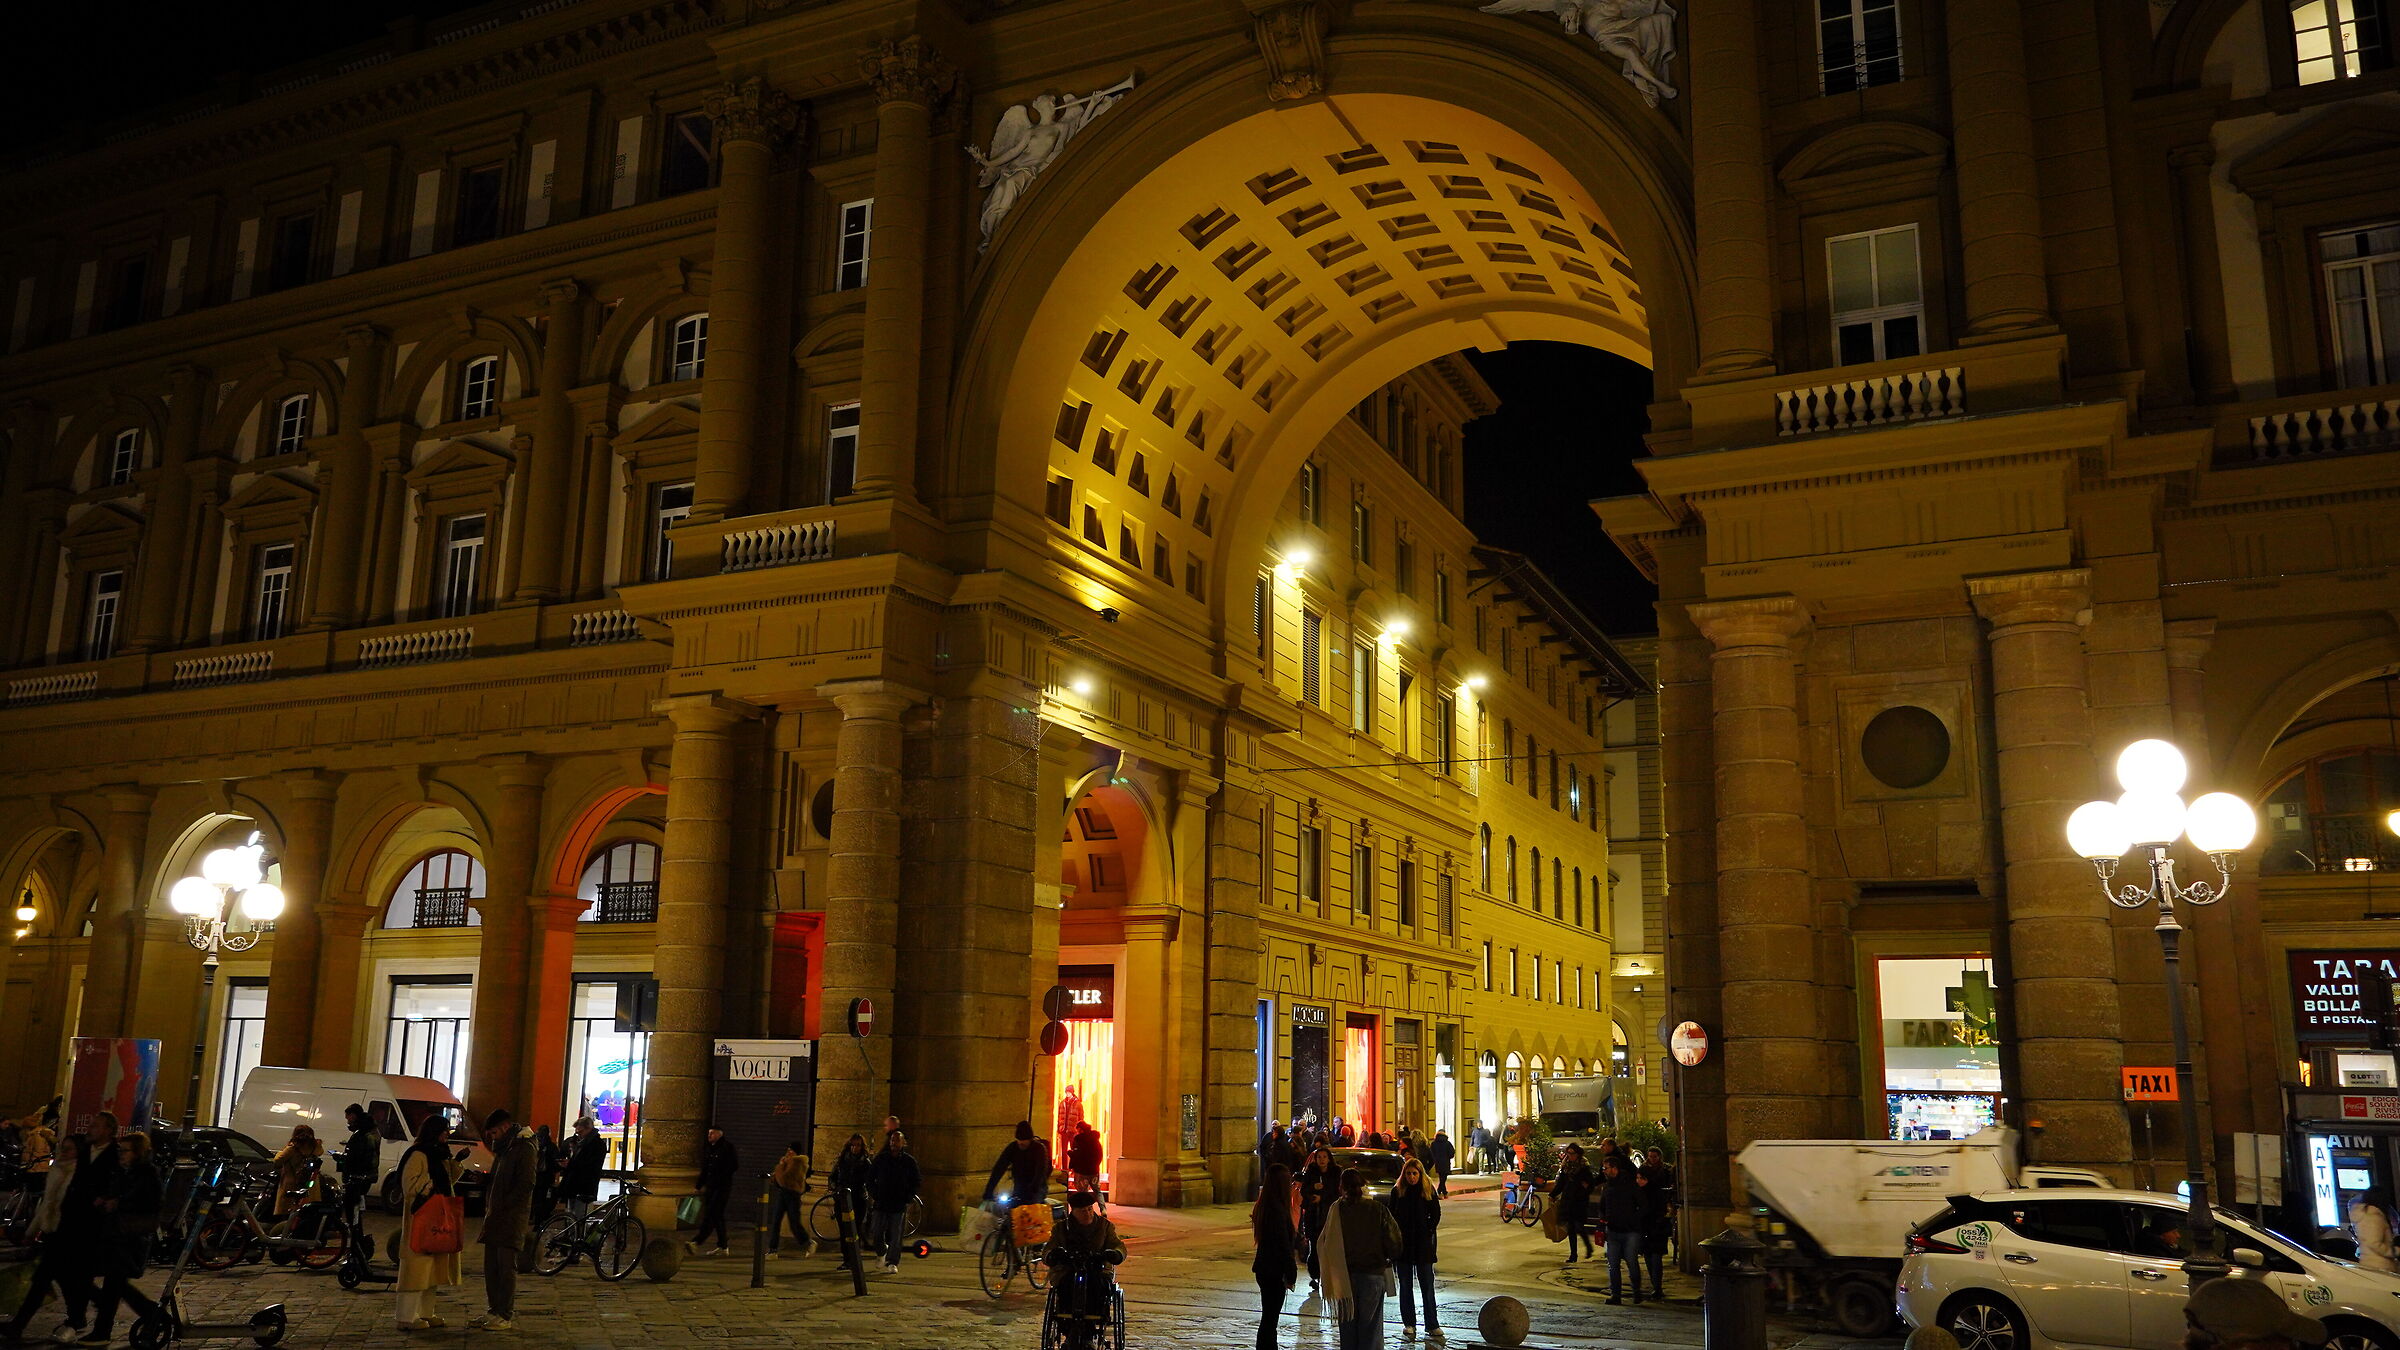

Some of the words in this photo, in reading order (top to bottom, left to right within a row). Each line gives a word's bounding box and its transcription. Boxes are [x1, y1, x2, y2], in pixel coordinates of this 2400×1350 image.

[2310, 1016, 2318, 1024] E
[733, 1059, 789, 1079] VOGUE
[2129, 1075, 2171, 1093] TAXI
[2327, 1135, 2374, 1149] ATM
[2316, 1147, 2331, 1199] ATM
